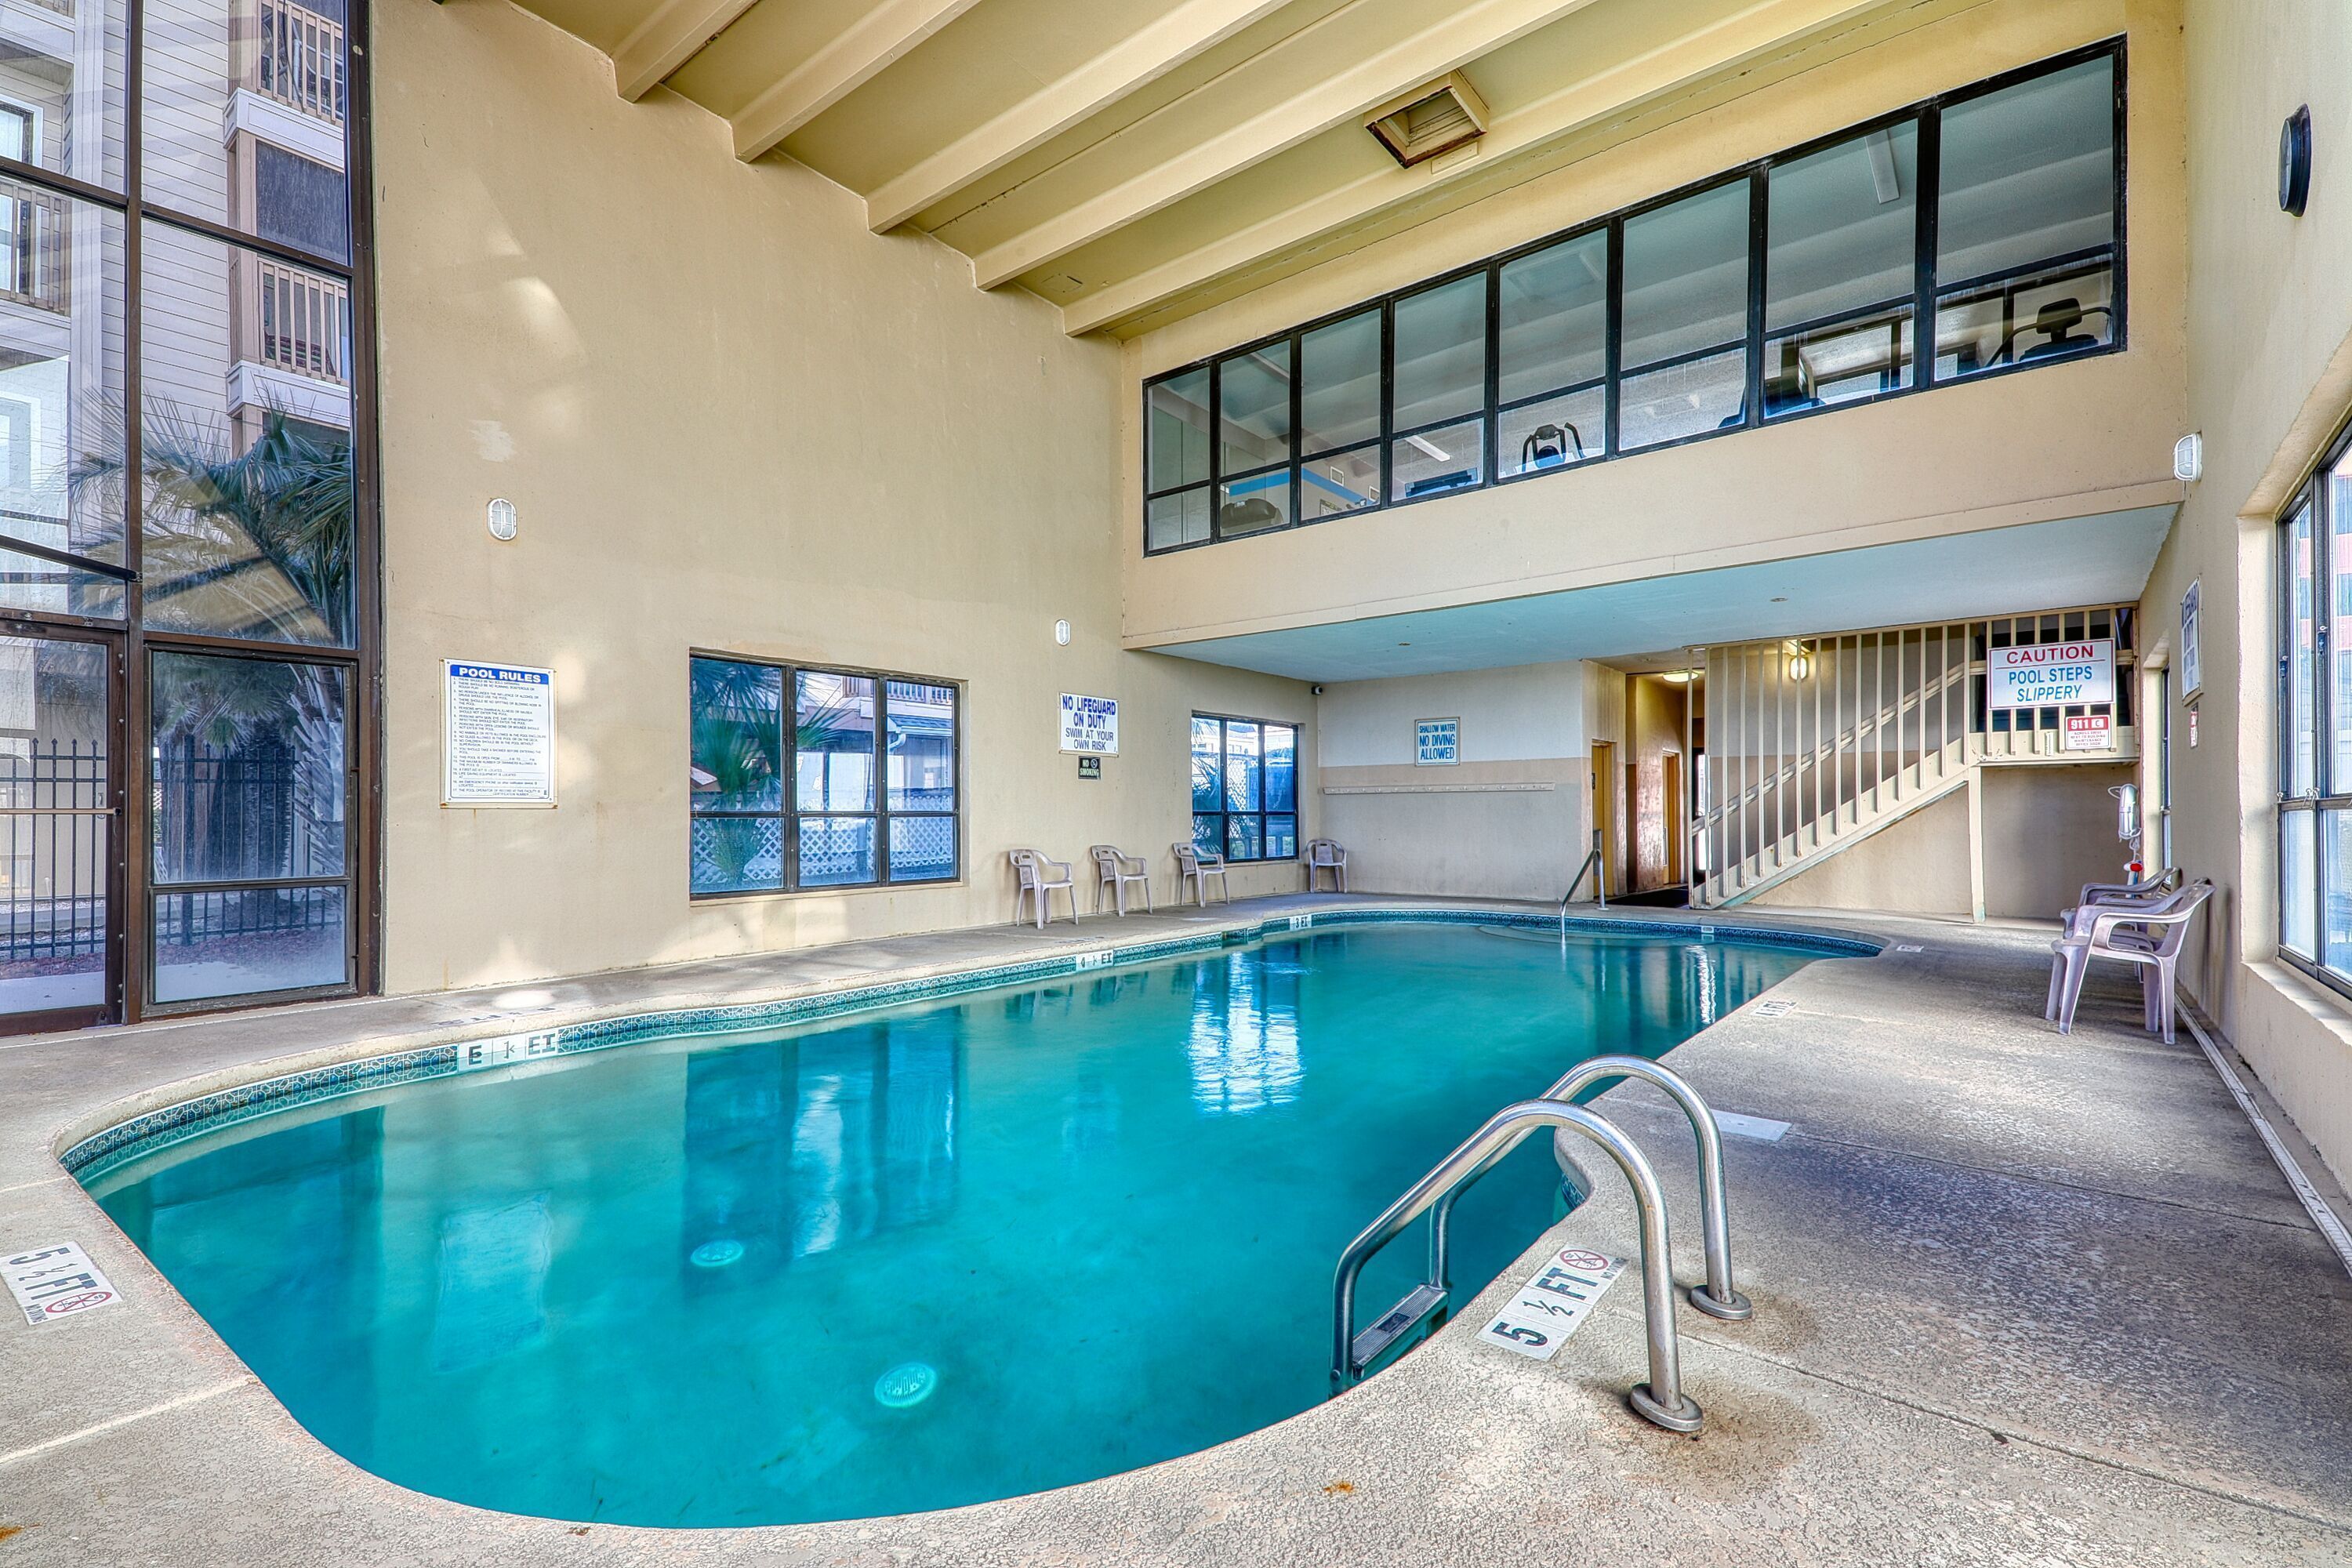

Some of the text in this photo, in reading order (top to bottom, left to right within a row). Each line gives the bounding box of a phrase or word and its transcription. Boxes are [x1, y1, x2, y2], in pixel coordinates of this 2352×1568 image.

[2006, 644, 2093, 664] CAUTION
[459, 667, 541, 682] POOL RULES
[2009, 666, 2092, 684] POOL STEPS
[2016, 684, 2082, 702] SLIPPERY
[1062, 695, 1116, 715] NO LIFEGUARD
[1073, 712, 1106, 729] ON DUTY
[1419, 724, 1456, 733] SHALLOW WATER
[2071, 720, 2089, 729] 911
[1065, 728, 1113, 741] SWIM AT YOUR
[1420, 734, 1455, 746] NO DIVING
[1074, 739, 1106, 751] OWN RISK
[1420, 747, 1454, 760] ALLOWED
[1082, 759, 1090, 768] NO
[9, 1247, 71, 1265] 5
[25, 1272, 98, 1300] FT
[1491, 1322, 1548, 1347] 5
[1536, 1267, 1599, 1301] FT
